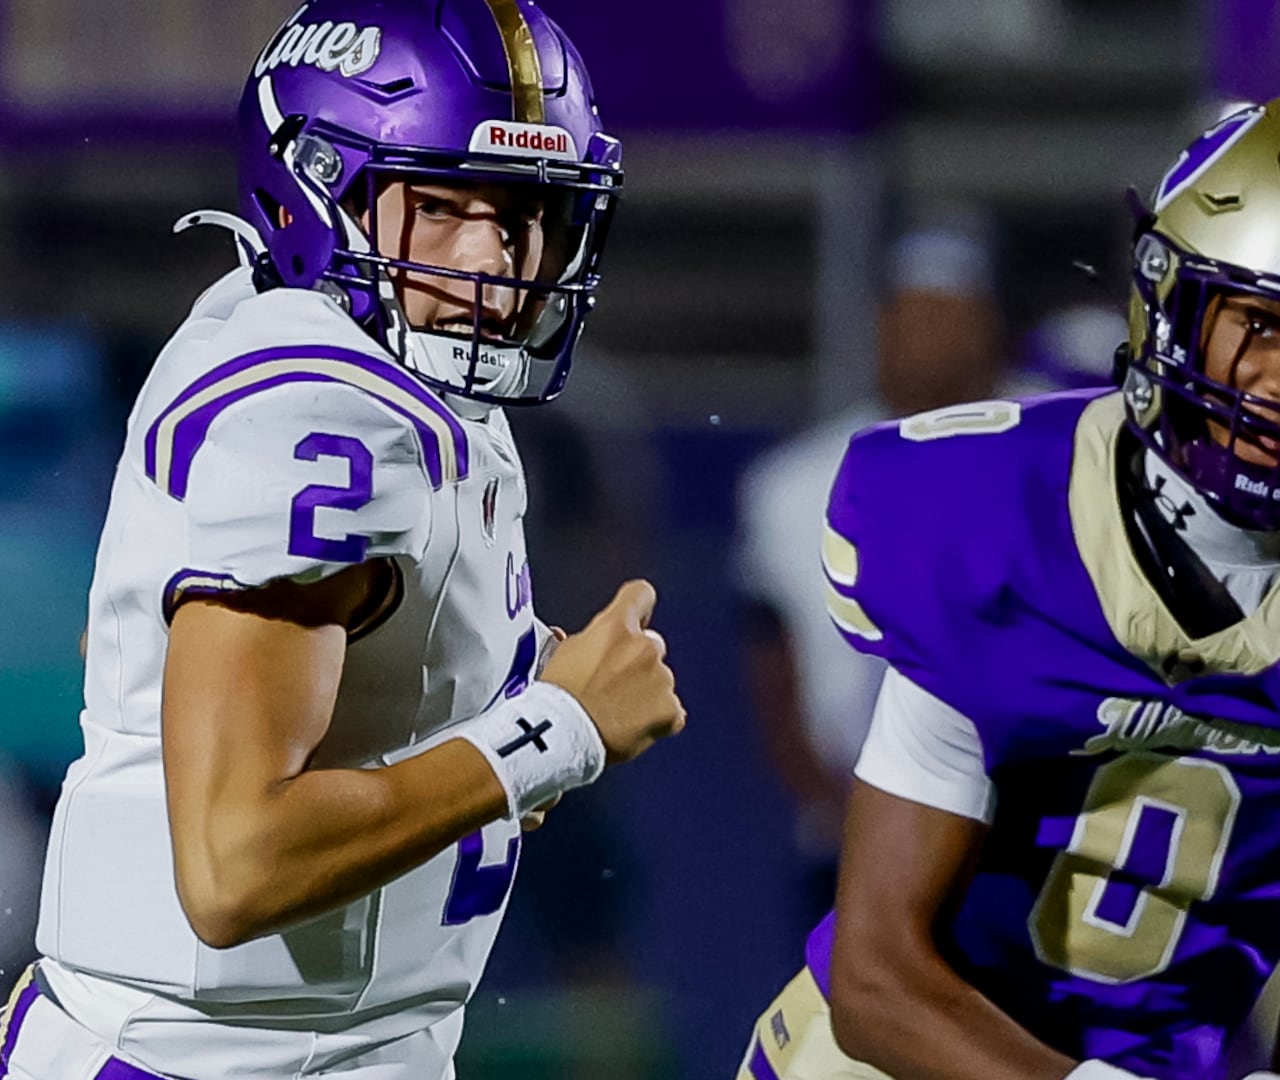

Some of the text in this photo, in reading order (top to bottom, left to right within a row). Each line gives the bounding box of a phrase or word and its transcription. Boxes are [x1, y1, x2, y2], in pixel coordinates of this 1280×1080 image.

[490, 126, 567, 153] Riddell
[900, 400, 1021, 442] 0
[287, 432, 373, 563] 2
[1028, 752, 1242, 985] 0
